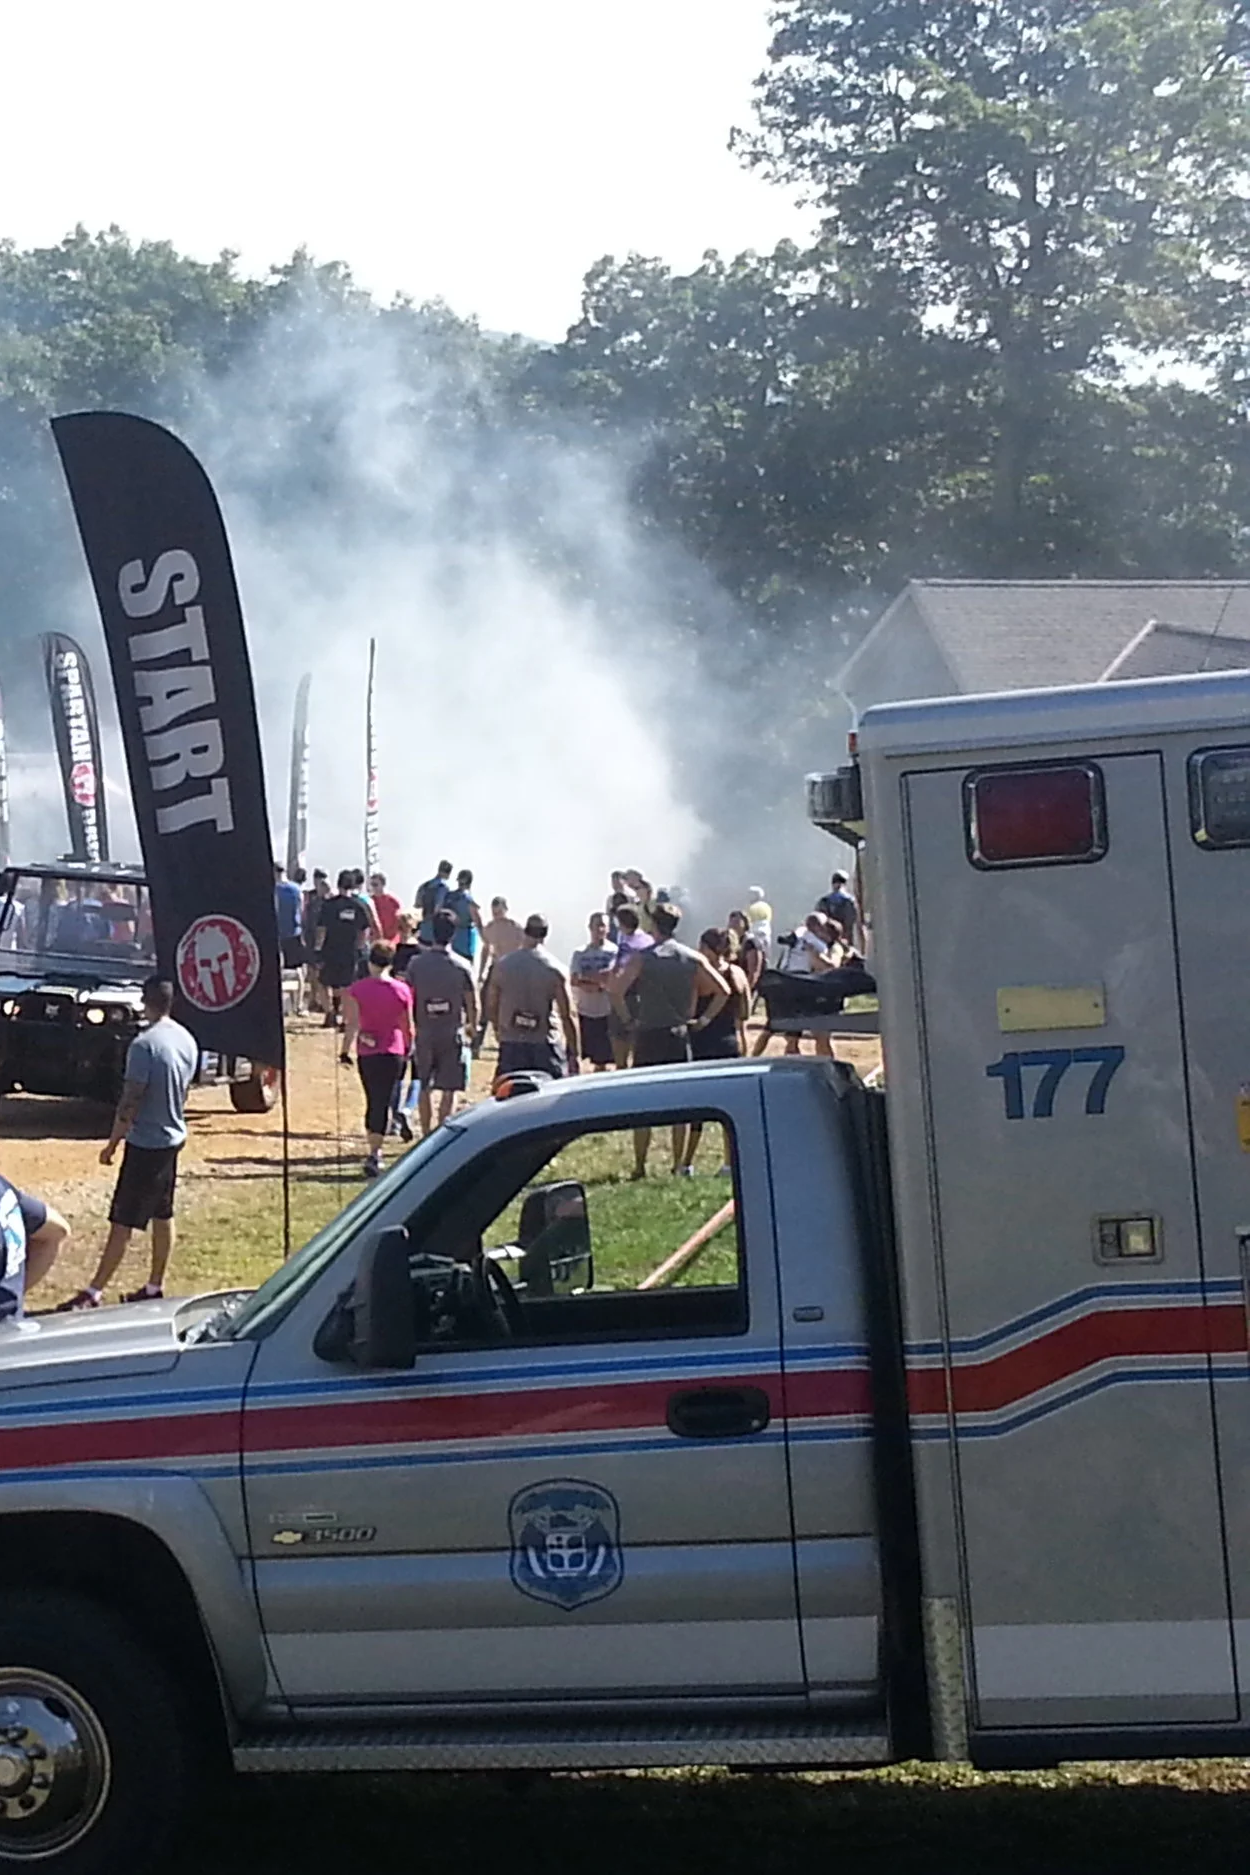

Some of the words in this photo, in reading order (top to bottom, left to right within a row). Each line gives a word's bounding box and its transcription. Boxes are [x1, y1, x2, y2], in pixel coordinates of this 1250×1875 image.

[54, 651, 93, 763] SPARTAN
[118, 549, 234, 834] START
[986, 1045, 1125, 1120] 177
